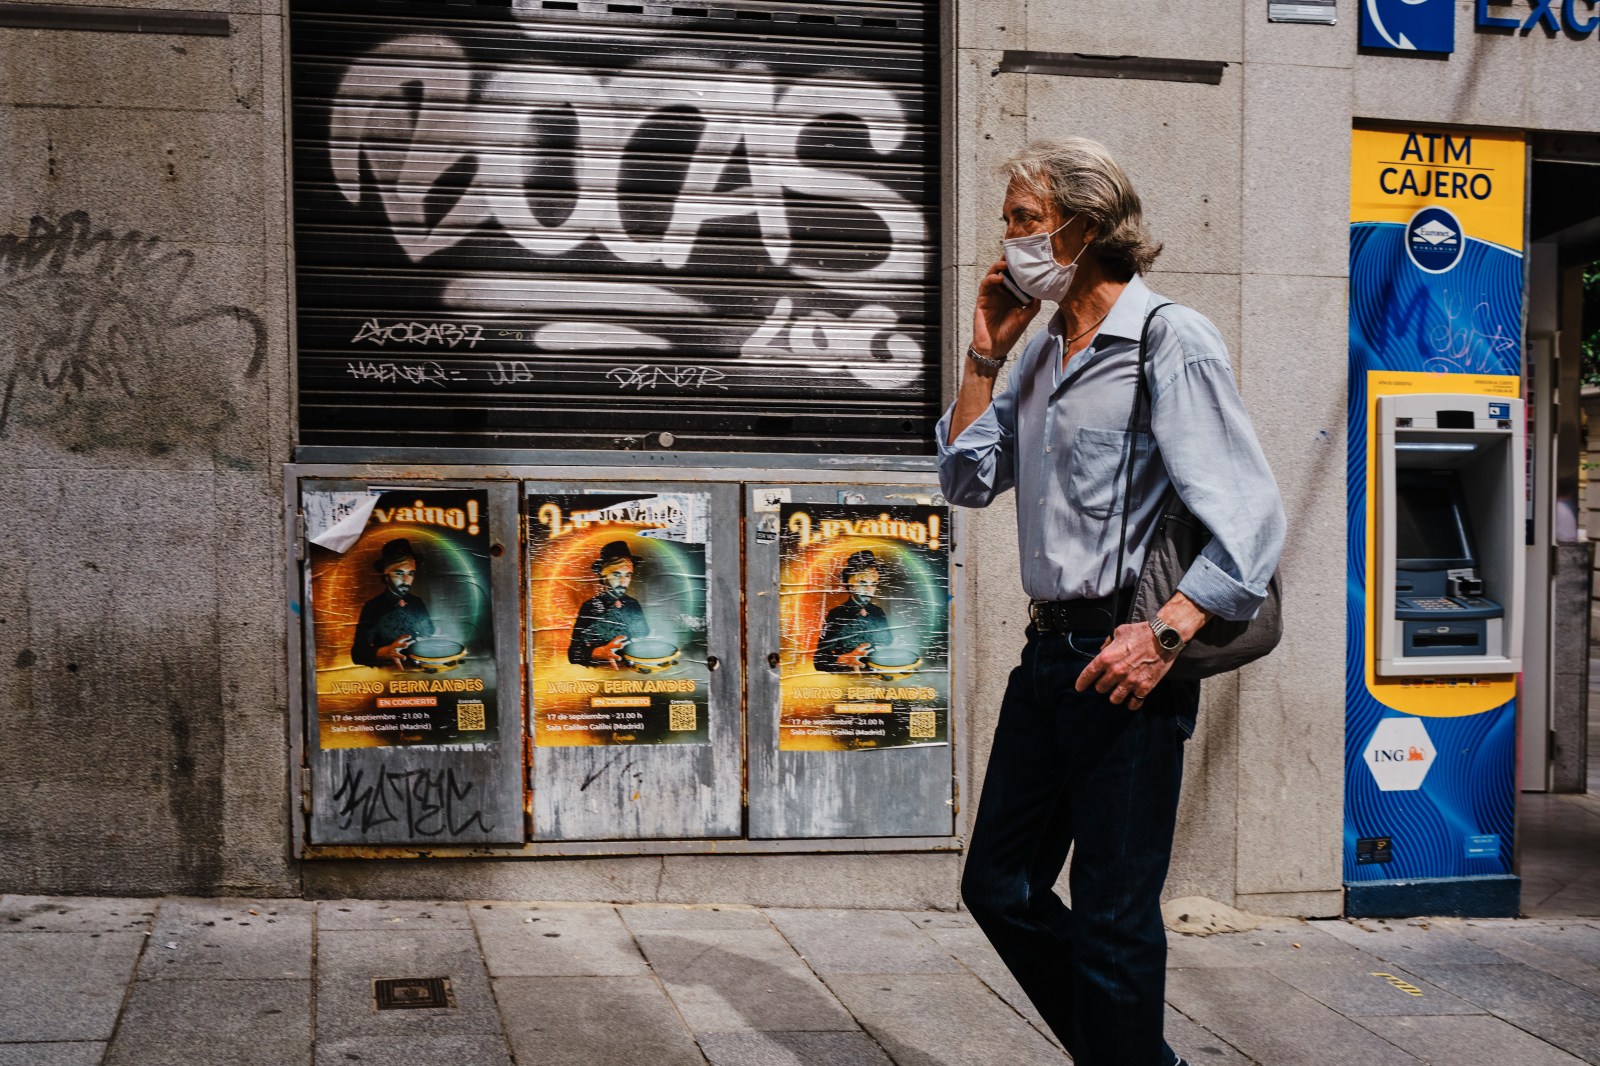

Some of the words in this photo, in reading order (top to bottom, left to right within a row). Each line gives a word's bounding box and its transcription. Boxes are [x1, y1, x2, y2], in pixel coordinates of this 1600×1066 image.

[1400, 131, 1473, 165] ATM
[1379, 167, 1492, 200] CAJERO
[389, 678, 484, 693] FERNANDES
[604, 679, 695, 693] FERNANDES
[847, 687, 935, 701] FERNANDES
[392, 698, 436, 706] CONCIERTO
[354, 713, 396, 722] septiembre
[402, 712, 422, 720] 21.00
[569, 712, 610, 722] septiembre
[375, 723, 398, 731] Galilei
[400, 723, 432, 731] (Madrid)
[589, 723, 612, 731] Galilei
[613, 722, 645, 731] (Madrid)
[855, 728, 886, 736] (Madrid)
[1374, 749, 1405, 762] ING
